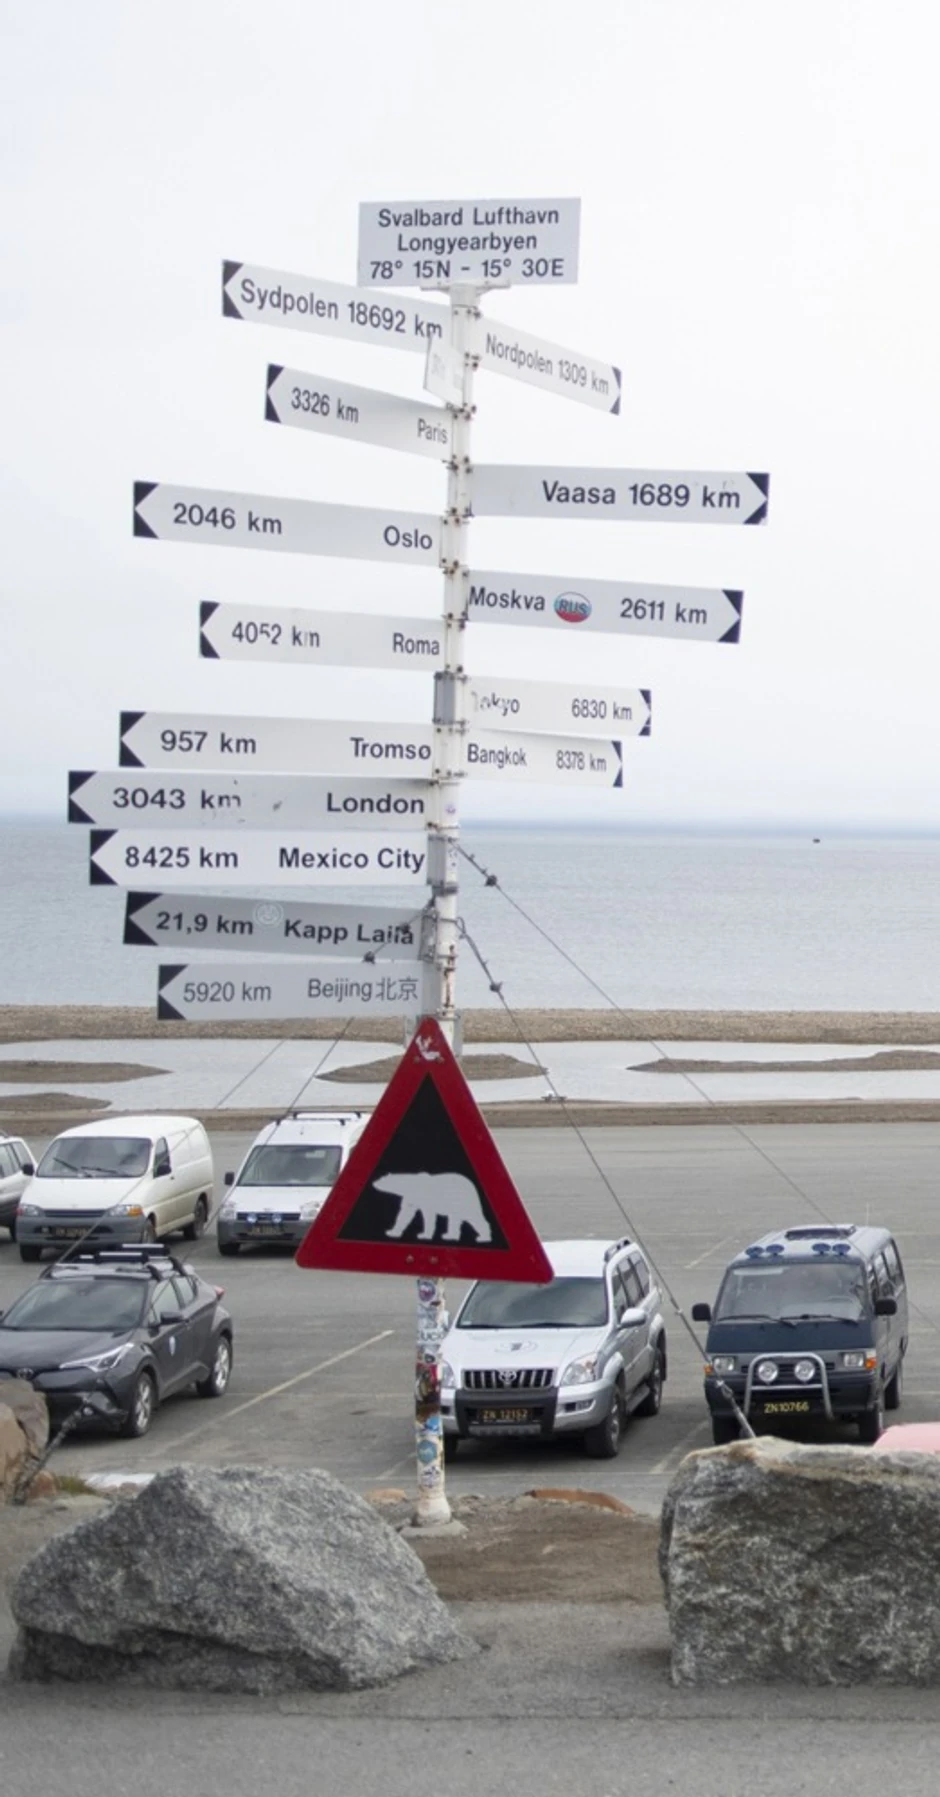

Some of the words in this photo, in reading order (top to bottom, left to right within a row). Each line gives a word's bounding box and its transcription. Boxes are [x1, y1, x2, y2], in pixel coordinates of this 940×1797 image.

[378, 208, 463, 227] Svalbard
[473, 207, 559, 225] Lufthavn
[398, 232, 537, 255] Longyearbyen
[240, 279, 338, 319] Sydpolen
[347, 301, 406, 334] 18692
[414, 315, 442, 338] km
[486, 334, 553, 376] Nordpolen
[558, 360, 587, 388] 1309
[591, 374, 609, 395] km
[291, 387, 330, 417] 3326
[336, 398, 359, 424] km
[417, 419, 448, 445] Paris
[543, 480, 616, 504] Vaasa
[629, 483, 690, 507] 1689
[702, 485, 740, 508] km
[173, 502, 236, 530] 2046
[248, 511, 282, 534] km
[383, 525, 432, 549] Oslo
[469, 586, 545, 611] Moskva
[620, 598, 664, 621] 2611
[676, 603, 707, 625] km
[556, 598, 587, 615] RUS
[232, 621, 282, 645] 4052
[393, 632, 440, 655] Roma
[572, 698, 607, 719] 6830
[613, 702, 632, 720] km
[160, 730, 208, 752] 957
[220, 733, 256, 754] km
[350, 737, 431, 760] Tromsø
[467, 743, 527, 768] Bangkok
[556, 750, 585, 771] 8378
[590, 754, 607, 772] km
[113, 787, 186, 809] 3043
[201, 789, 241, 809] km
[326, 793, 425, 814] London
[125, 847, 190, 868] 8425
[200, 847, 238, 868] km
[279, 848, 369, 869] Mexico
[377, 847, 425, 874] City
[156, 911, 208, 934] 21,9
[217, 915, 253, 935] km
[284, 919, 348, 944] Kapp
[183, 981, 235, 1002] 5920
[242, 982, 271, 1001] km
